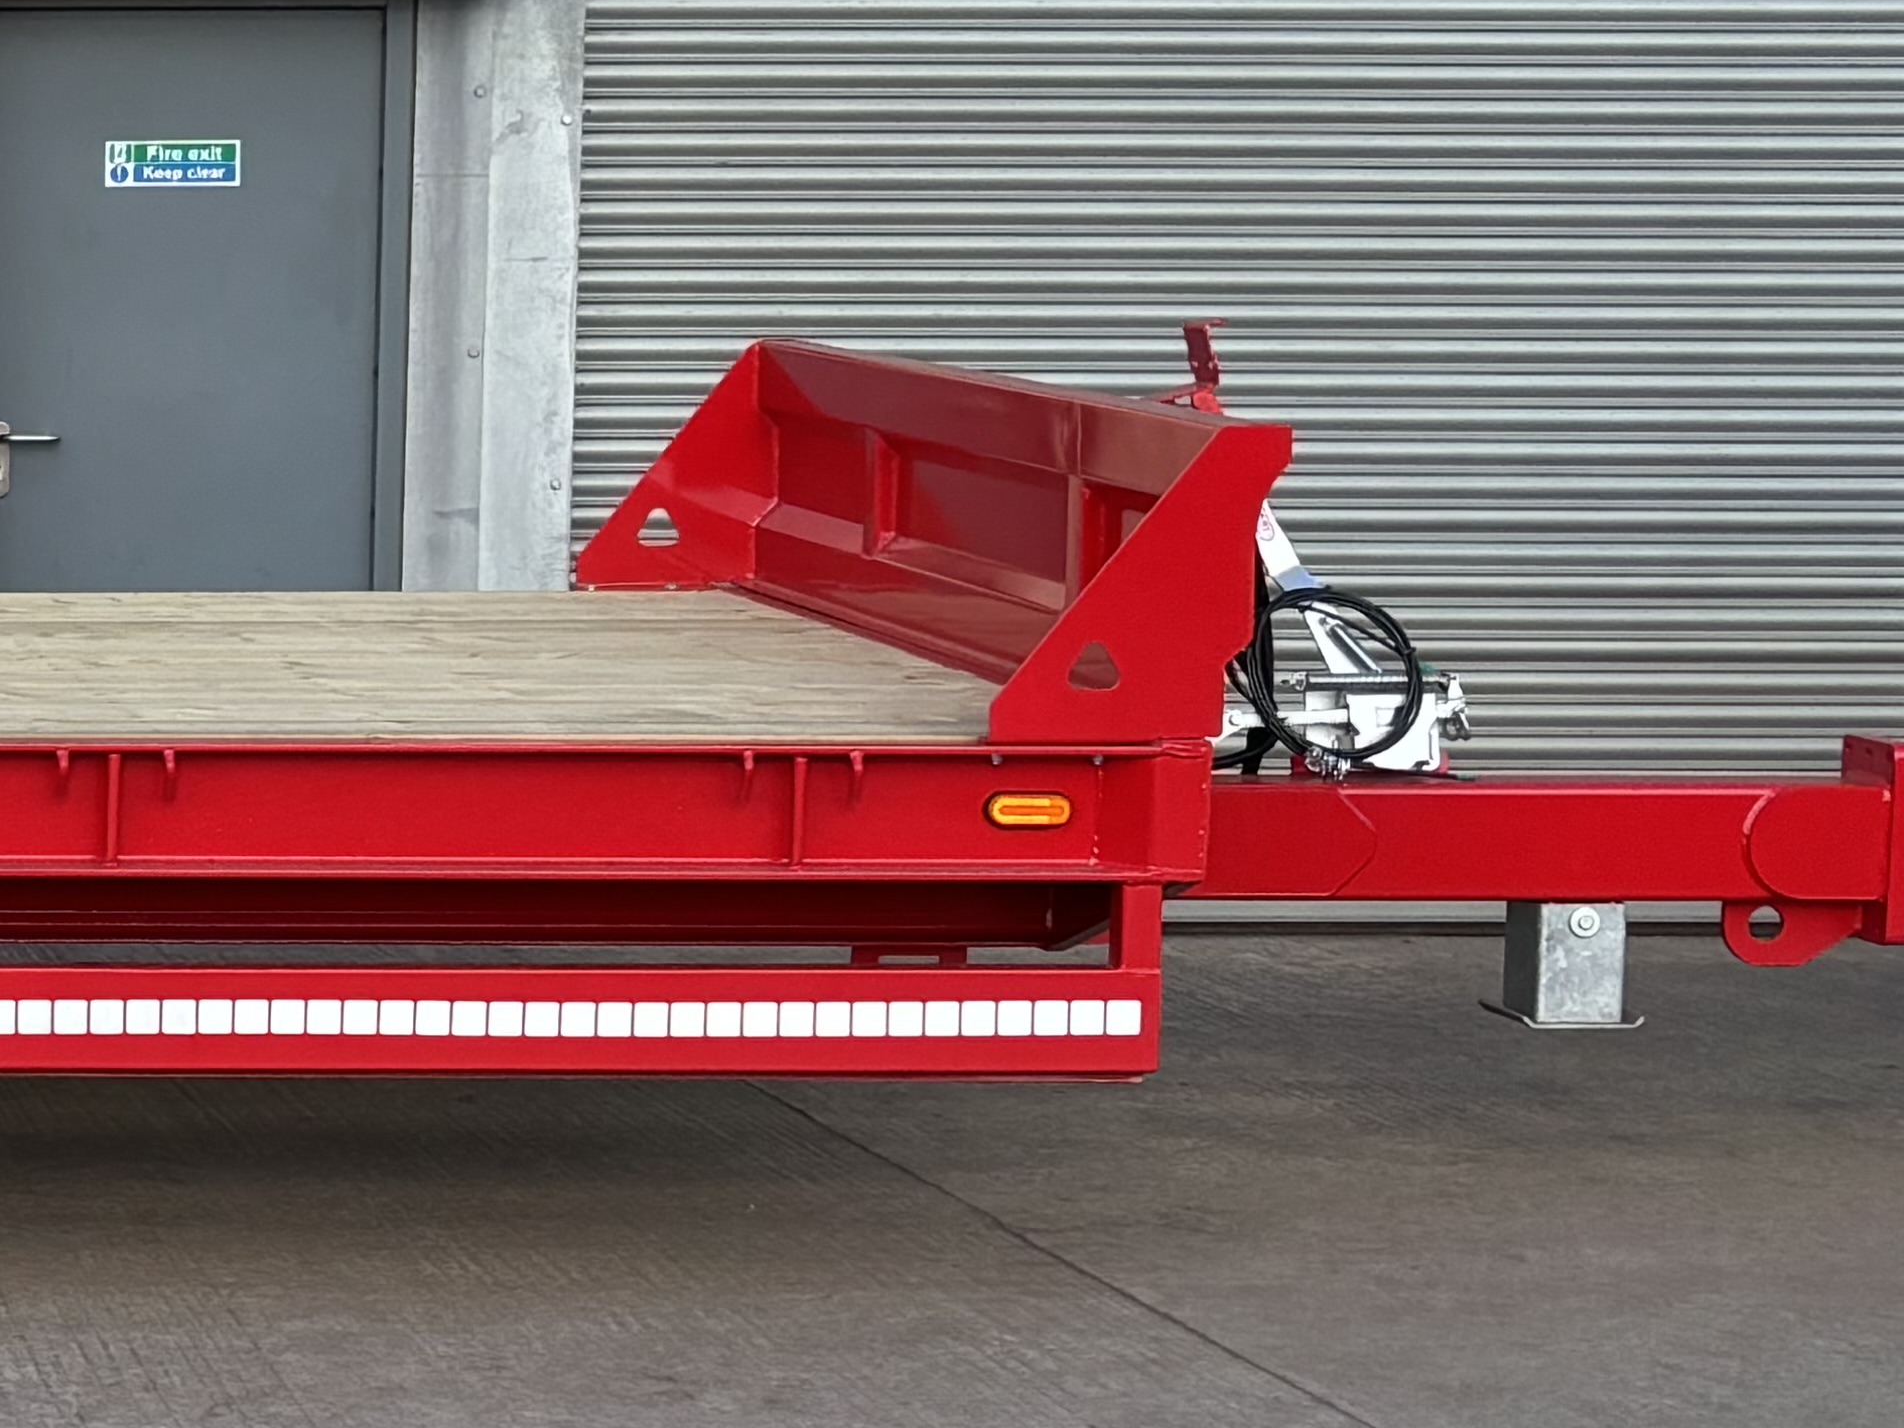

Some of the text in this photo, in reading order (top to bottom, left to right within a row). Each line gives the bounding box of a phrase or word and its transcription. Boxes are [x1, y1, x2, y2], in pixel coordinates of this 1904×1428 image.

[146, 145, 223, 161] Fire exit
[143, 166, 226, 180] Keep clear
